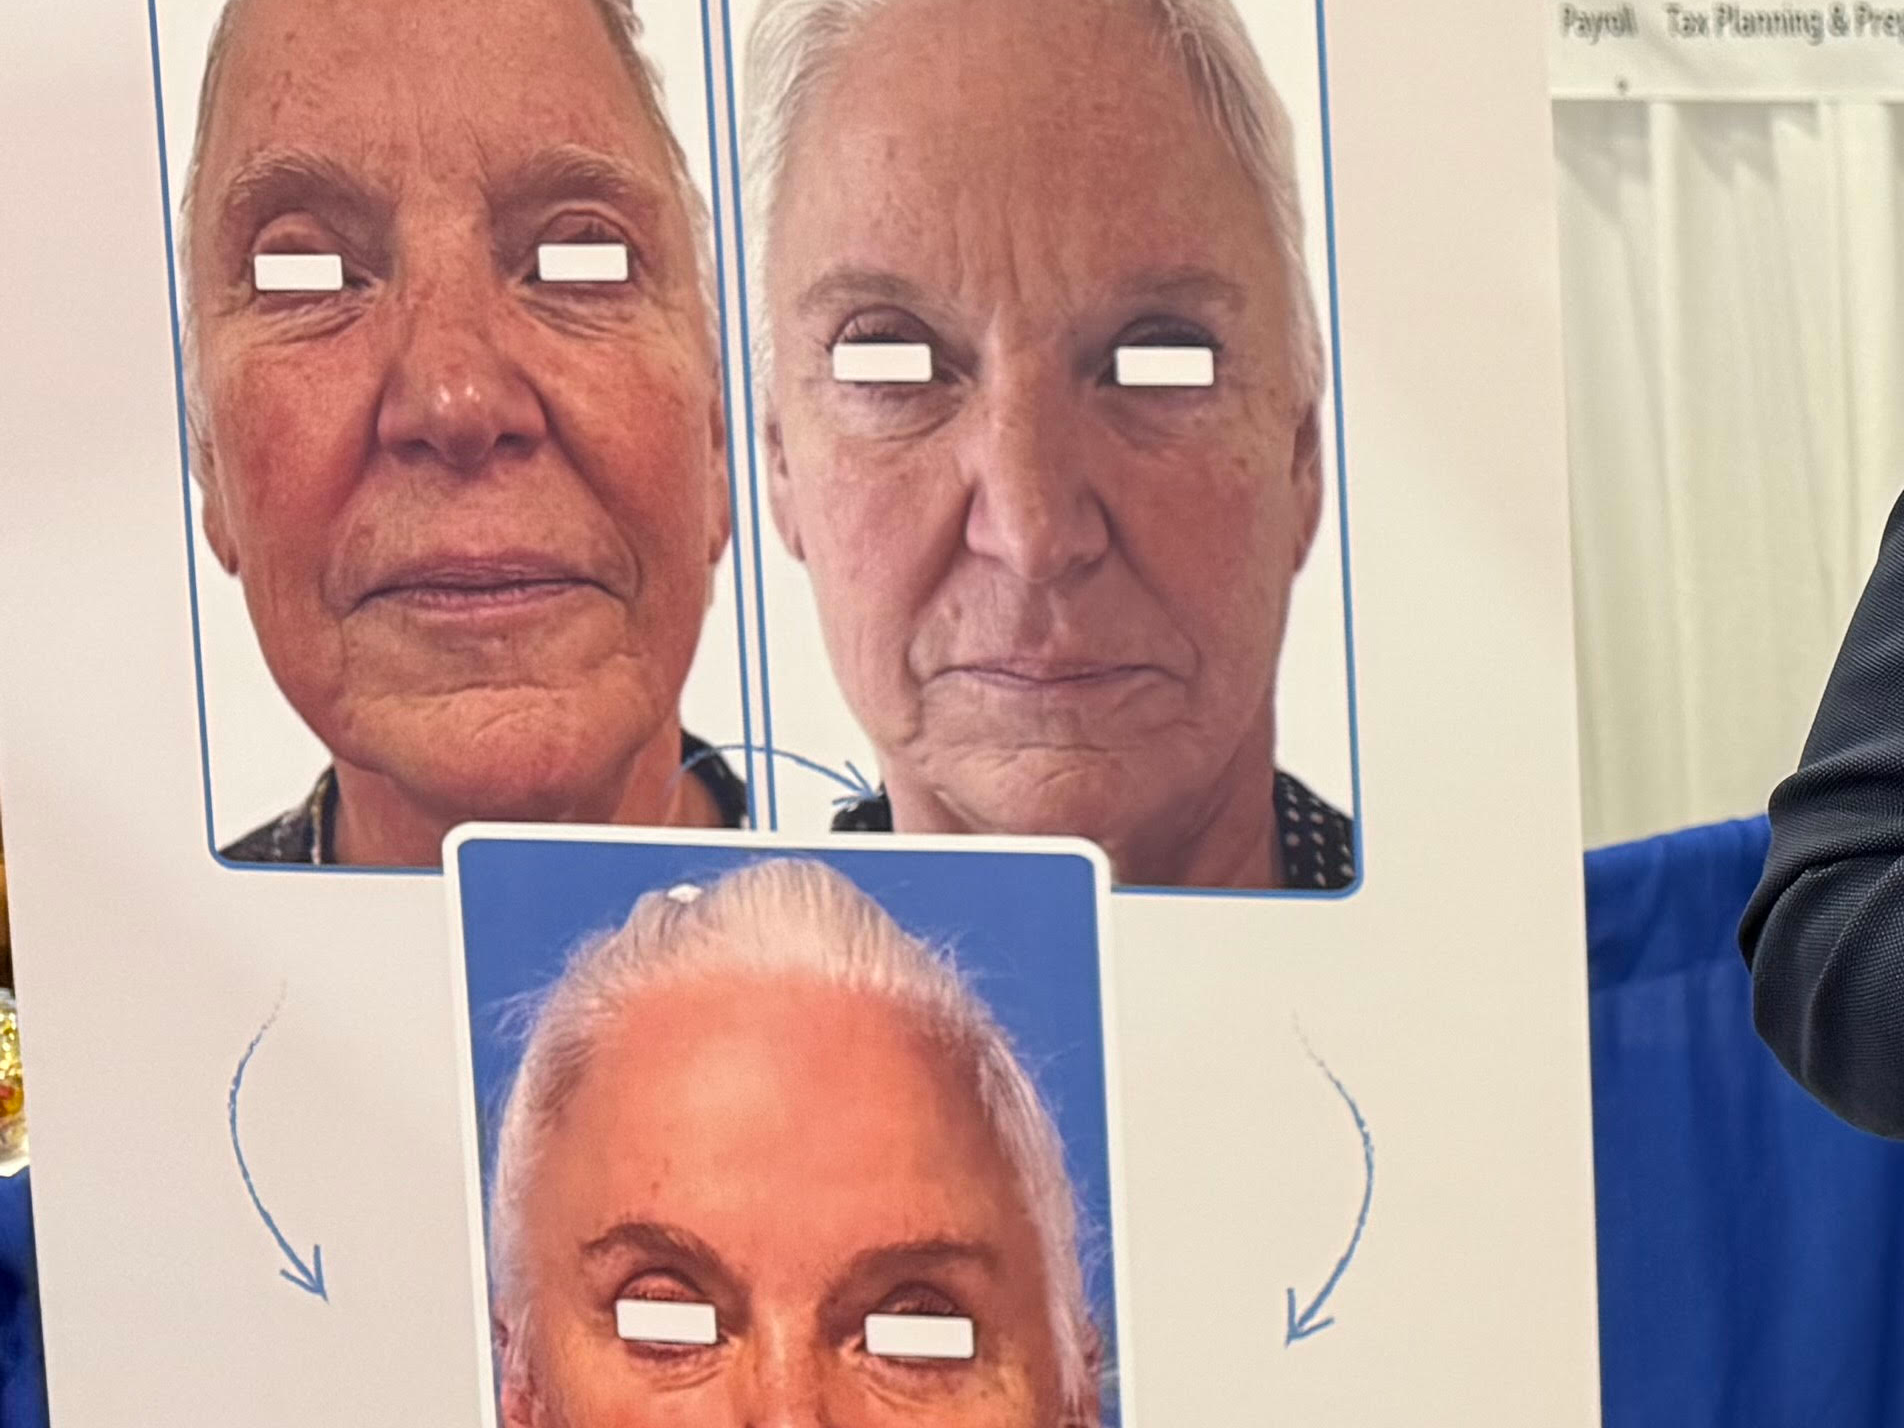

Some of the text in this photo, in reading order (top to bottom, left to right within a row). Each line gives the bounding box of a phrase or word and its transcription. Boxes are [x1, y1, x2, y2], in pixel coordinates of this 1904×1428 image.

[1561, 4, 1638, 46] Payroll
[1666, 3, 1710, 38] Tax
[1714, 1, 1825, 45] Planning
[1828, 2, 1851, 35] &
